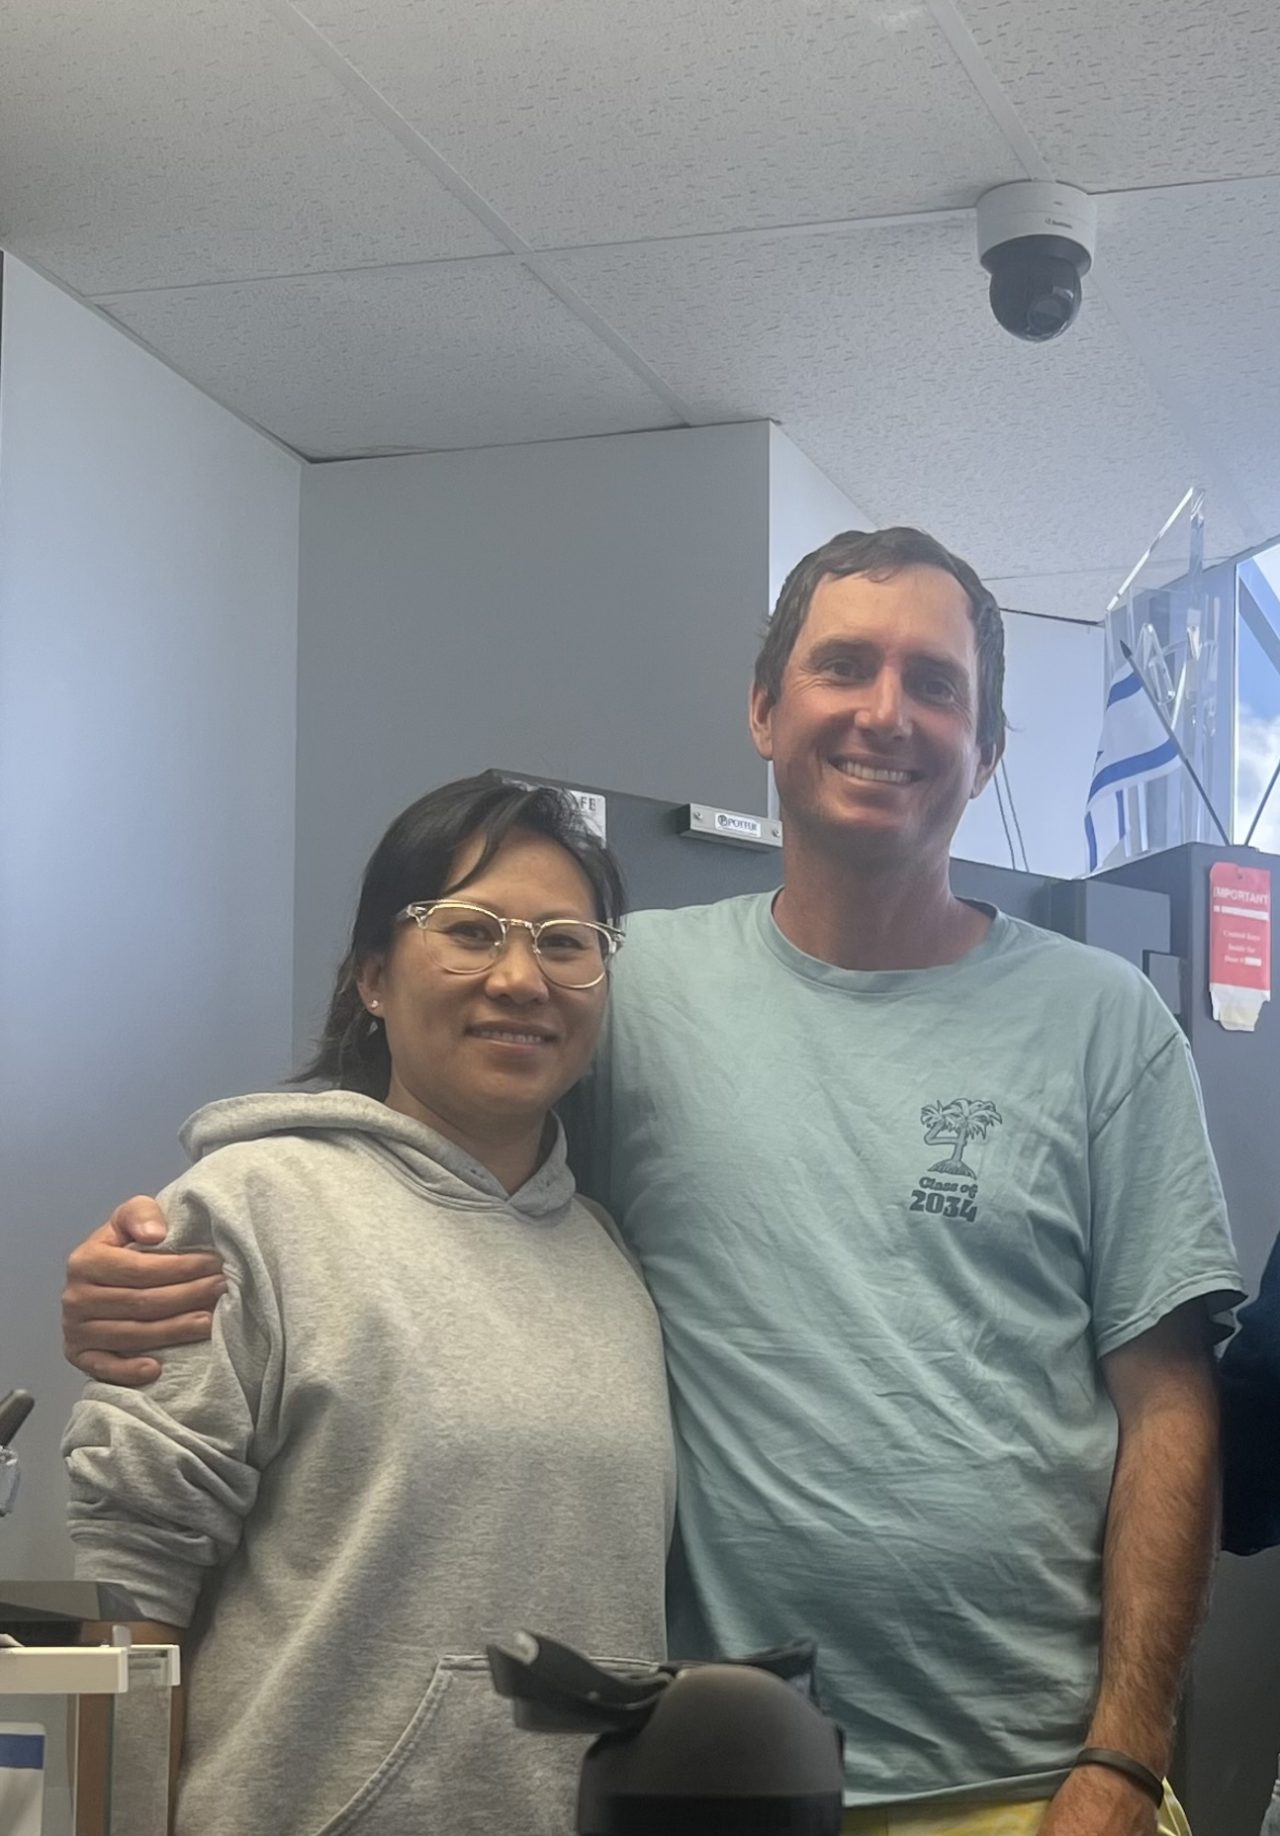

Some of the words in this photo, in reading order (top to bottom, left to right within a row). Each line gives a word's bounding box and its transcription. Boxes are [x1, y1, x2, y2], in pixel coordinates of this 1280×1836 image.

[580, 796, 597, 811] FE
[1213, 886, 1268, 904] IMPORTANT
[919, 1177, 959, 1192] Class
[960, 1183, 978, 1199] of
[909, 1189, 978, 1222] 2034
